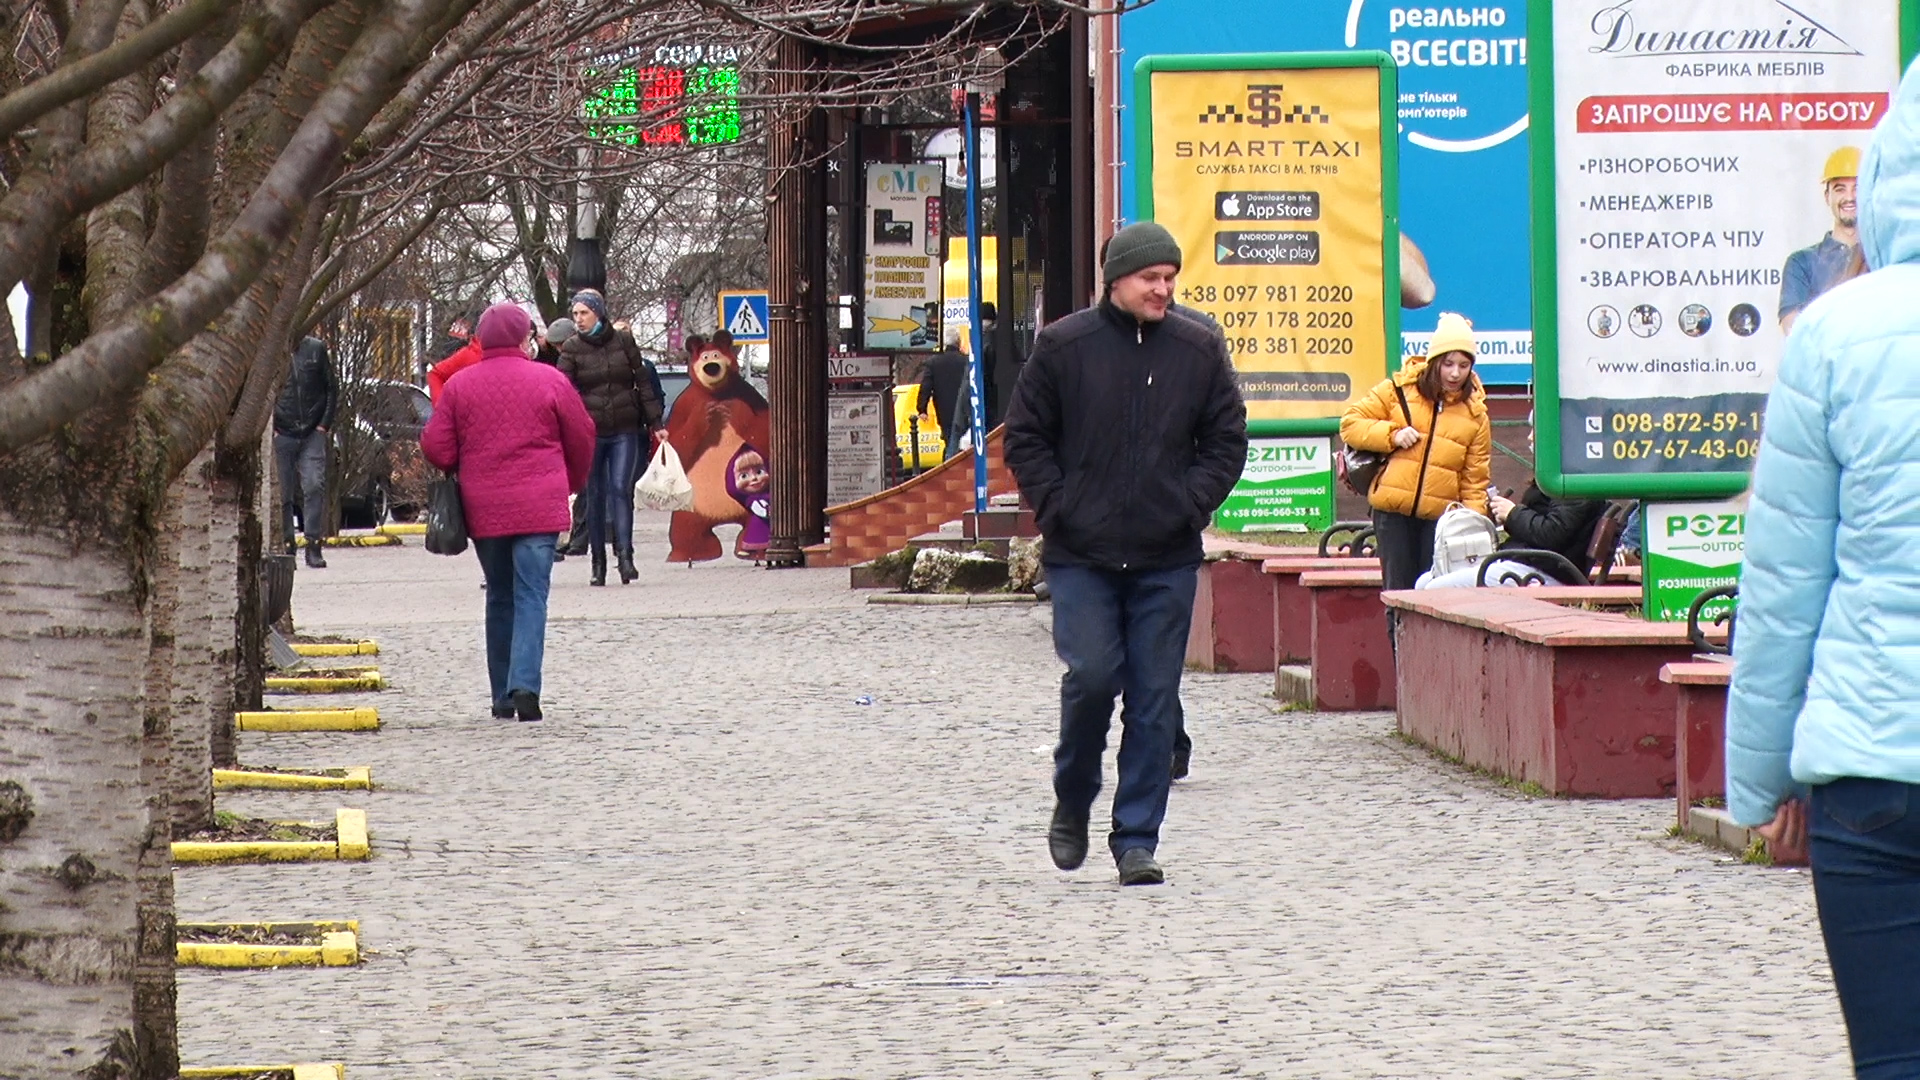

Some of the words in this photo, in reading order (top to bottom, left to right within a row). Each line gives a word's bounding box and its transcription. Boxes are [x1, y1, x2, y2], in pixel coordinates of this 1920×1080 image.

[1389, 7, 1506, 33] реально
[1588, 6, 1819, 54] Династія
[1391, 38, 1527, 67] ВСЕСВІТ!
[1665, 62, 1752, 77] ФАБРИКА
[1757, 62, 1825, 76] МЕБЛІВ
[1418, 91, 1457, 103] тільки
[1397, 106, 1467, 120] омп'ютерів
[1591, 103, 1732, 125] ЗАПРОШУЄ
[1739, 103, 1773, 122] НА
[1781, 100, 1876, 122] РОБОТУ
[1175, 140, 1285, 158] SMART
[1293, 140, 1360, 157] TAXI
[1196, 164, 1245, 175] СЛУЖБА
[1249, 164, 1281, 174] ТАКСІ
[1284, 164, 1290, 174] В
[1293, 164, 1307, 174] М.
[1310, 164, 1338, 174] ТЯЧІВ
[1588, 156, 1740, 174] РІЗНОРОБОЧИХ
[1247, 194, 1285, 202] Download
[1298, 194, 1312, 202] the
[1589, 194, 1713, 212] МЕНЕДЖЕРІВ
[1246, 203, 1275, 219] App
[1276, 203, 1313, 217] Store
[1237, 233, 1276, 241] ANDROID
[1277, 233, 1294, 241] APP
[1295, 233, 1309, 241] ON
[1589, 231, 1717, 249] ОПЕРАТОРА
[1723, 231, 1765, 248] ЧПУ
[874, 256, 931, 268] СМАРТФОНИ
[1237, 244, 1287, 263] Google
[1289, 245, 1317, 262] play
[1589, 269, 1781, 287] ЗВАРЮВАЛЬНИКІВ
[1181, 285, 1217, 302] +38
[1223, 285, 1258, 302] 097
[1265, 285, 1297, 302] 981
[1306, 285, 1353, 302] 2020
[1223, 311, 1258, 329] 097
[1266, 311, 1300, 329] 178
[1306, 311, 1353, 329] 2020
[1265, 337, 1297, 354] 381
[1306, 337, 1353, 354] 2020
[1597, 358, 1757, 373] www.dinastia.in.ua
[1239, 381, 1347, 393] .taxismart.com.ua
[1611, 412, 1765, 433] 098-872-59-1
[1247, 445, 1318, 462] OZITIV
[1612, 439, 1760, 460] 067-67-43-06
[1250, 465, 1293, 473] OUTDOOR
[1274, 486, 1326, 496] ЗОВНІШНЬОЇ
[1254, 497, 1292, 505] РЕКЛАМИ
[1232, 509, 1249, 518] +38
[1251, 507, 1320, 518] 096-060-3311
[1666, 513, 1745, 537] POZI
[1701, 542, 1745, 552] OUTDO
[1658, 577, 1737, 589] РОЗМІЩЕННЯ
